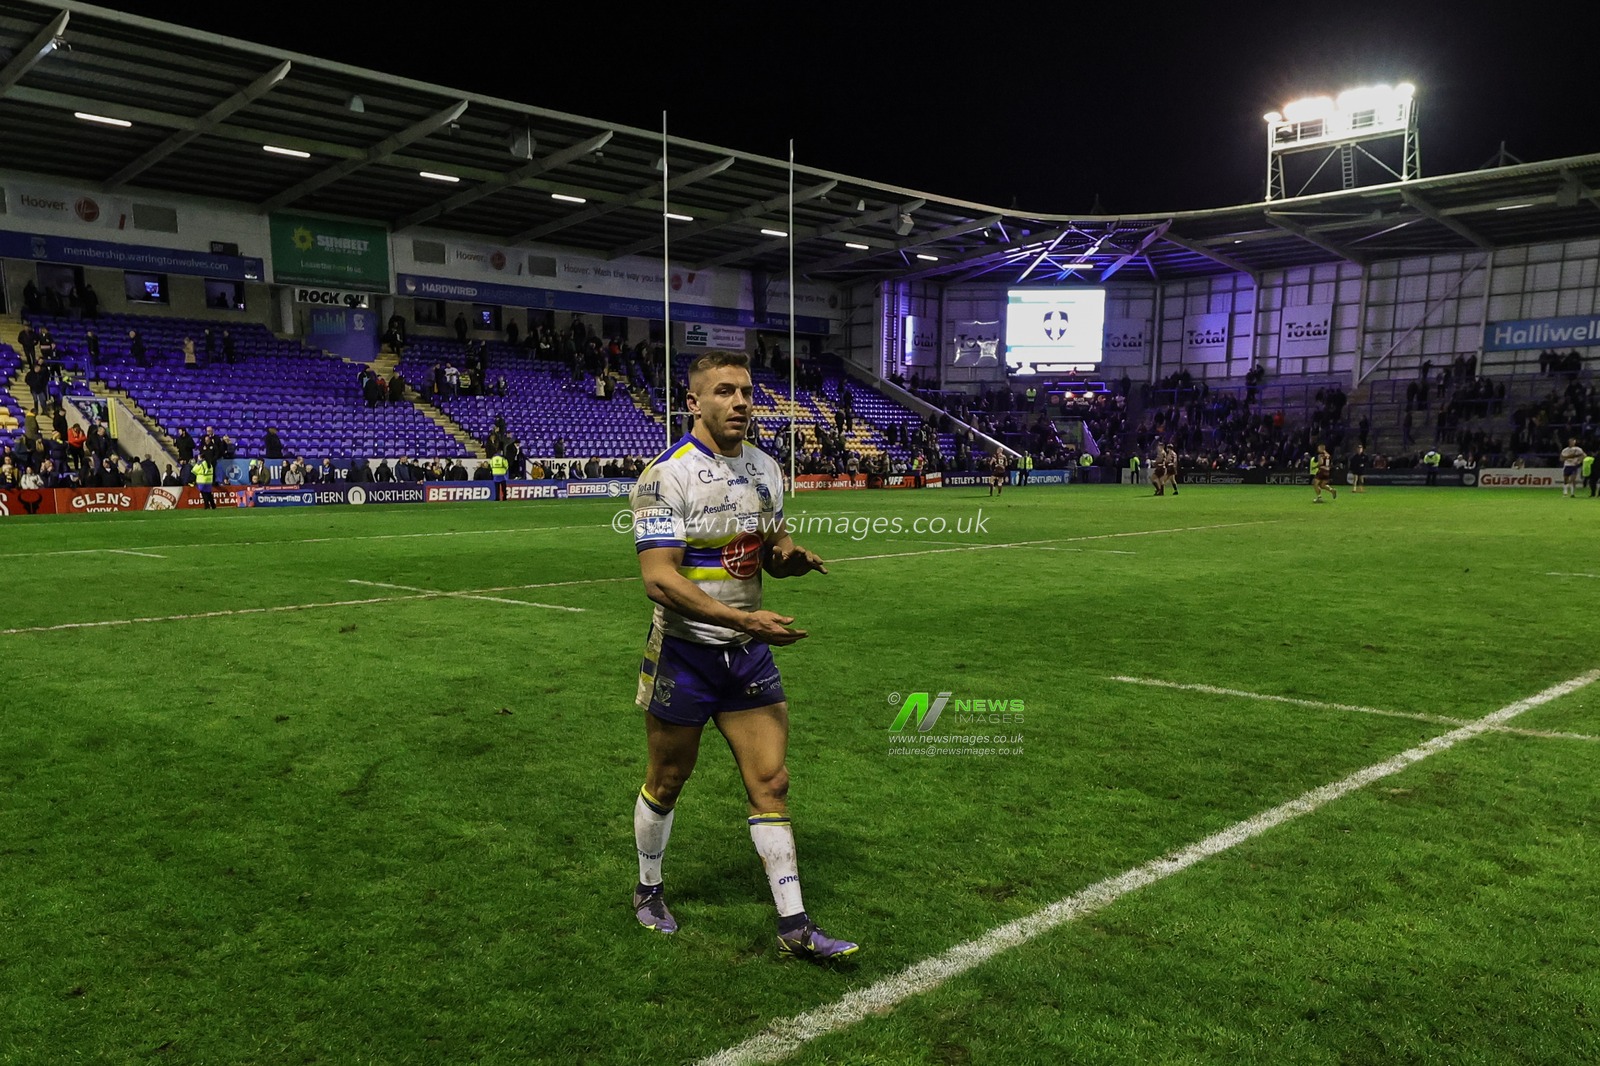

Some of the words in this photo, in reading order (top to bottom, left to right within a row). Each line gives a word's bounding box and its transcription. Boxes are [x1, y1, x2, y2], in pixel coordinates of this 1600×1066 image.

[63, 247, 229, 272] membership.warringtonwolves.com
[422, 282, 478, 297] HARDWIRED
[298, 289, 340, 305] ROCK
[1285, 319, 1329, 338] Total
[1186, 326, 1226, 345] Total
[794, 481, 814, 489] UNCLE
[815, 480, 832, 489] JOE'S
[833, 480, 848, 488] MINT
[1026, 475, 1062, 485] CENTURION
[1183, 476, 1195, 484] UK
[1480, 473, 1552, 486] Guardian
[369, 489, 422, 502] NORTHERN
[429, 486, 491, 501] BETFRED
[570, 485, 607, 494] BETFRED
[72, 492, 131, 509] GLEN'S
[636, 507, 672, 519] BETFRED
[703, 502, 738, 515] Resulting
